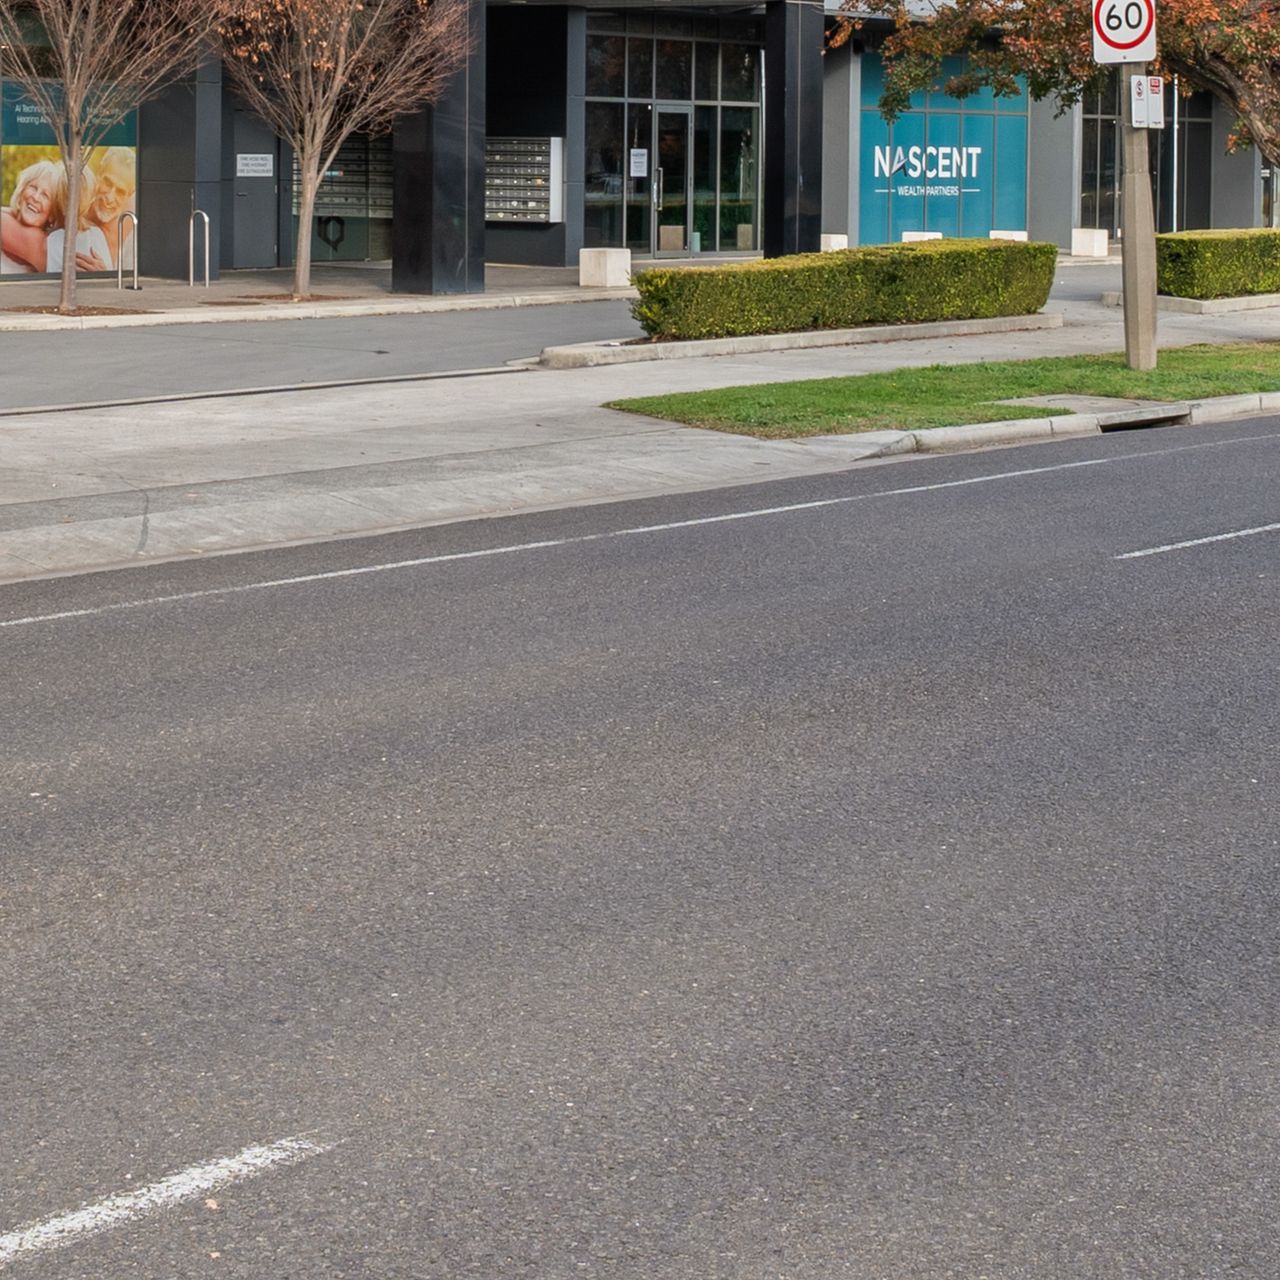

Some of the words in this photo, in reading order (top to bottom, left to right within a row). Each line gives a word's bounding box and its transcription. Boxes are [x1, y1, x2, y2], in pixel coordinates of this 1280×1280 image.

[1106, 1, 1142, 31] 60
[874, 145, 982, 178] NASCENT
[897, 186, 924, 196] WEALTH
[926, 186, 960, 196] PARTNERS
